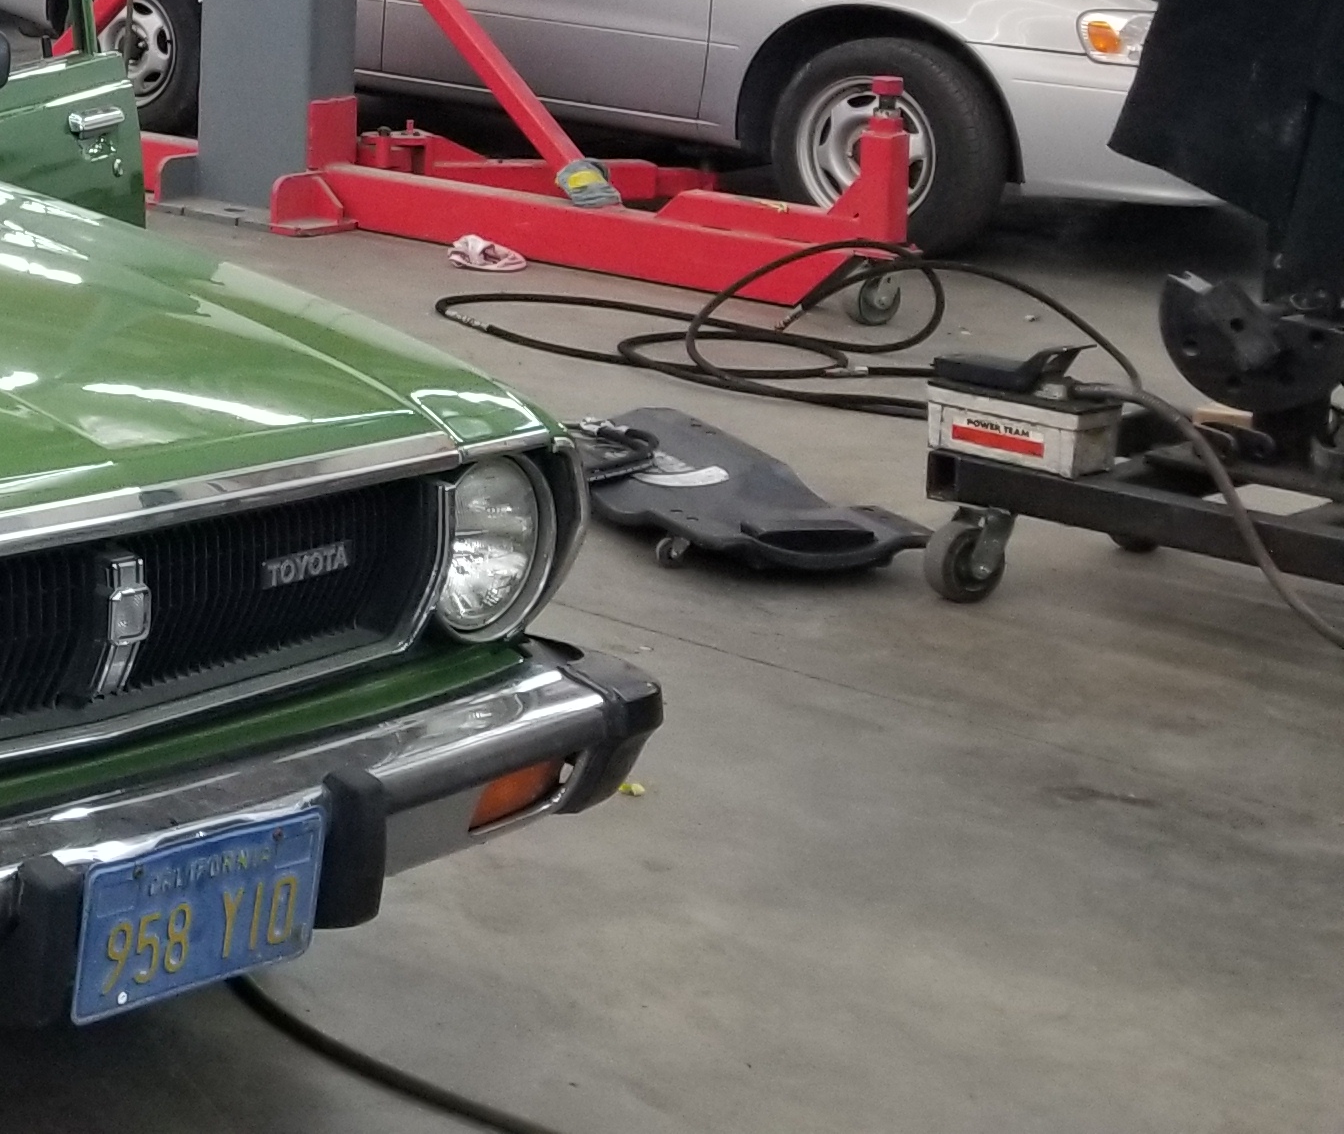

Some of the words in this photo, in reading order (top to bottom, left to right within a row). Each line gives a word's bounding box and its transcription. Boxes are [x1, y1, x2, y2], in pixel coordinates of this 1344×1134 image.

[966, 418, 1002, 433] POWER
[1003, 425, 1030, 438] TEAM
[267, 542, 349, 587] TOYOTA
[102, 901, 193, 995] 958
